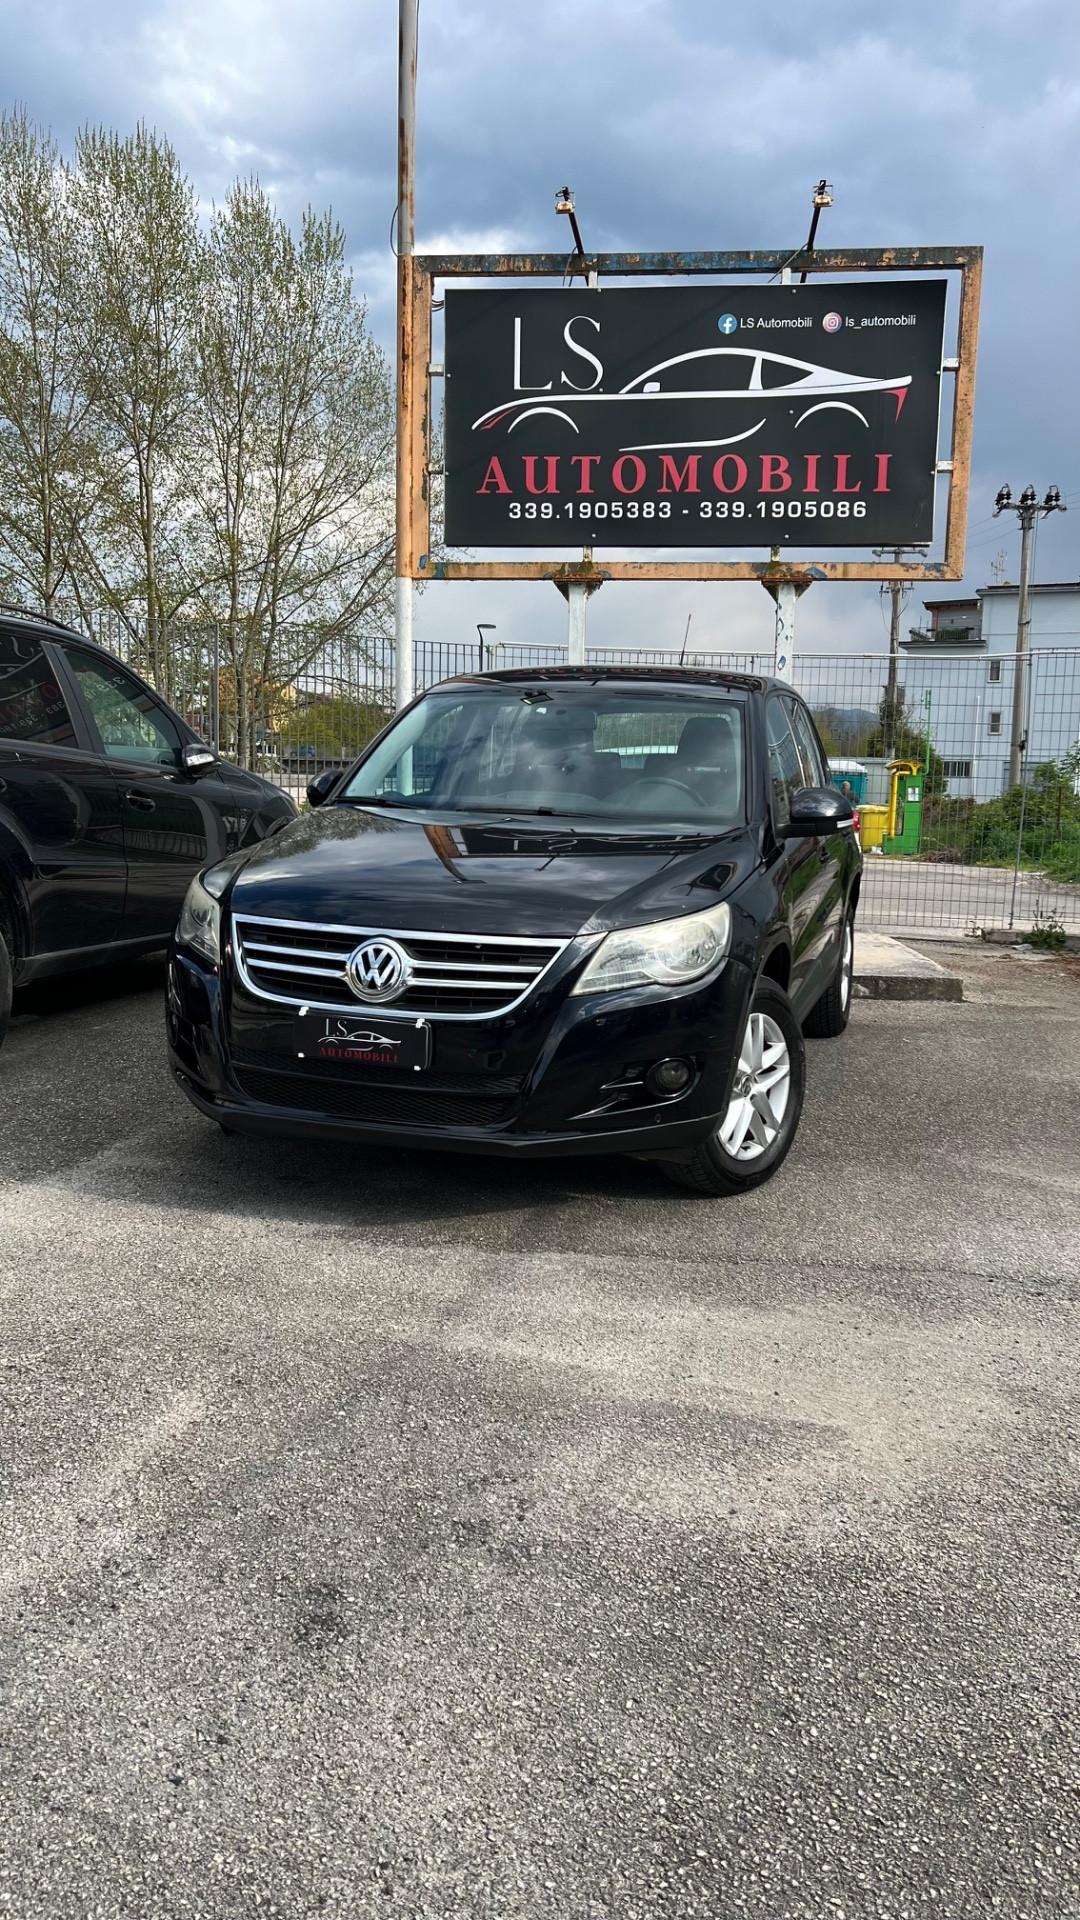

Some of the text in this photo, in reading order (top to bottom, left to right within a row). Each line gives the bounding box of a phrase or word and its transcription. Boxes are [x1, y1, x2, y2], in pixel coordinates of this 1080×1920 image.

[740, 317, 813, 329] LS Automobili
[845, 314, 917, 330] ls_automobili
[513, 315, 604, 392] LS
[476, 454, 894, 495] AUTOMOBILI
[508, 501, 673, 520] 339.1905383
[699, 500, 868, 519] 339.1905086
[319, 1047, 398, 1063] AUTOMOBILI
